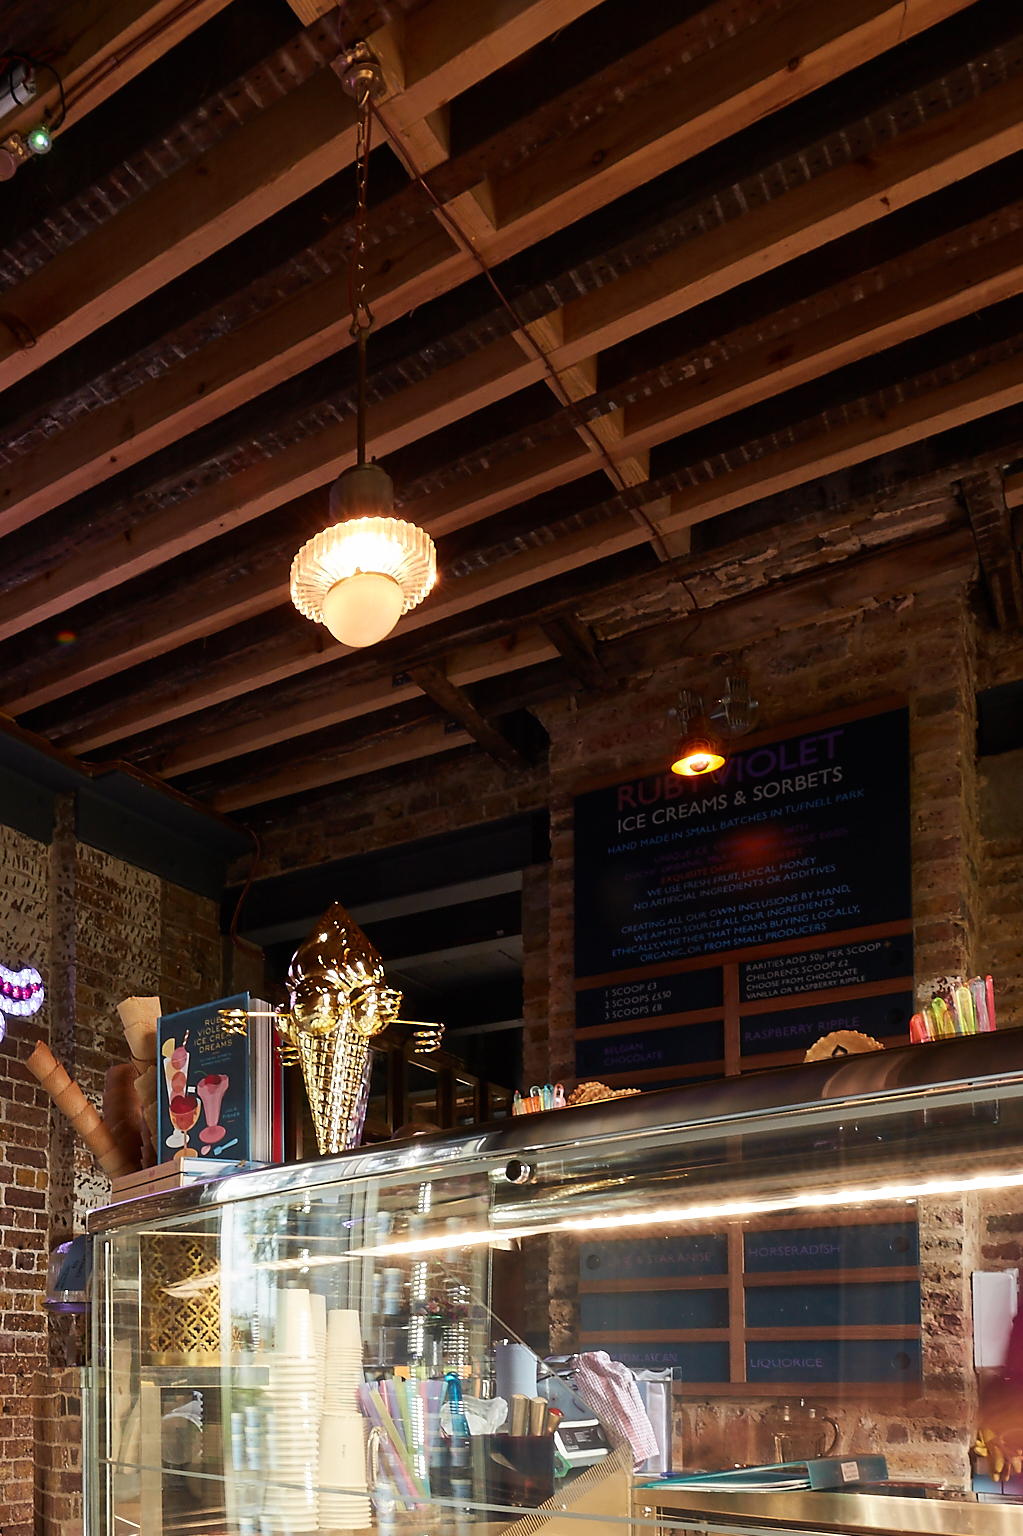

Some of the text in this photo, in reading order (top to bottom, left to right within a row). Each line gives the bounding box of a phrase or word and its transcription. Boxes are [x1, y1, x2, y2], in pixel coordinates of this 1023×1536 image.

[618, 766, 843, 833] ICE CREAMS & SORBETS
[607, 788, 865, 854] HAND MADE IN SMALL BATCHES IN TUFNELL PARK
[633, 864, 836, 911] NO ARTIFICIAL INGREDIENTS OR ADDITIVES
[647, 887, 662, 897] WE
[664, 884, 681, 894] USE
[683, 879, 711, 890] FRESH
[742, 866, 776, 878] LOCAL
[779, 856, 817, 870] HONEY
[621, 919, 666, 934] CREATING
[667, 916, 683, 925] ALL
[685, 911, 707, 922] OUR
[709, 905, 736, 917] OWN
[738, 893, 798, 912] INCLUSIONS
[801, 891, 814, 900] BY
[633, 898, 835, 942] WE AIM TO SOURCE ALL OUR INGREDIENTS
[687, 945, 701, 954] OR
[704, 939, 731, 951] FROM
[733, 934, 763, 946] SMALL
[765, 922, 827, 940] PRODUCERS
[706, 928, 731, 940] THAT
[733, 922, 768, 935] MEANS
[769, 914, 809, 929] BUYING
[745, 942, 882, 972] RARITIES ADD 50p PER SCOOP
[746, 959, 849, 983] CHILDREN'S SCOOP £2
[746, 967, 858, 992] CHOOSE FROM CHOCOLATE
[611, 983, 645, 997] SCOOP
[746, 975, 866, 1000] VANILLA OR RASPBERRY RIPPLE
[604, 1001, 610, 1009] 2
[611, 994, 650, 1008] SCOOPS
[604, 1011, 610, 1020] 3
[612, 1005, 650, 1019] SCOOPS
[193, 1036, 207, 1046] ICE
[197, 1024, 225, 1037] VIOLE
[744, 1016, 861, 1042] RASPBERRY RIPPLE
[198, 1039, 233, 1054] DREAMS
[603, 1043, 644, 1055] BELGIAN
[604, 1050, 664, 1067] CHOCOLATE
[677, 1251, 712, 1263] ANISE
[748, 1243, 841, 1258] HORSERADISH
[750, 1358, 823, 1369] LIQUORICE
